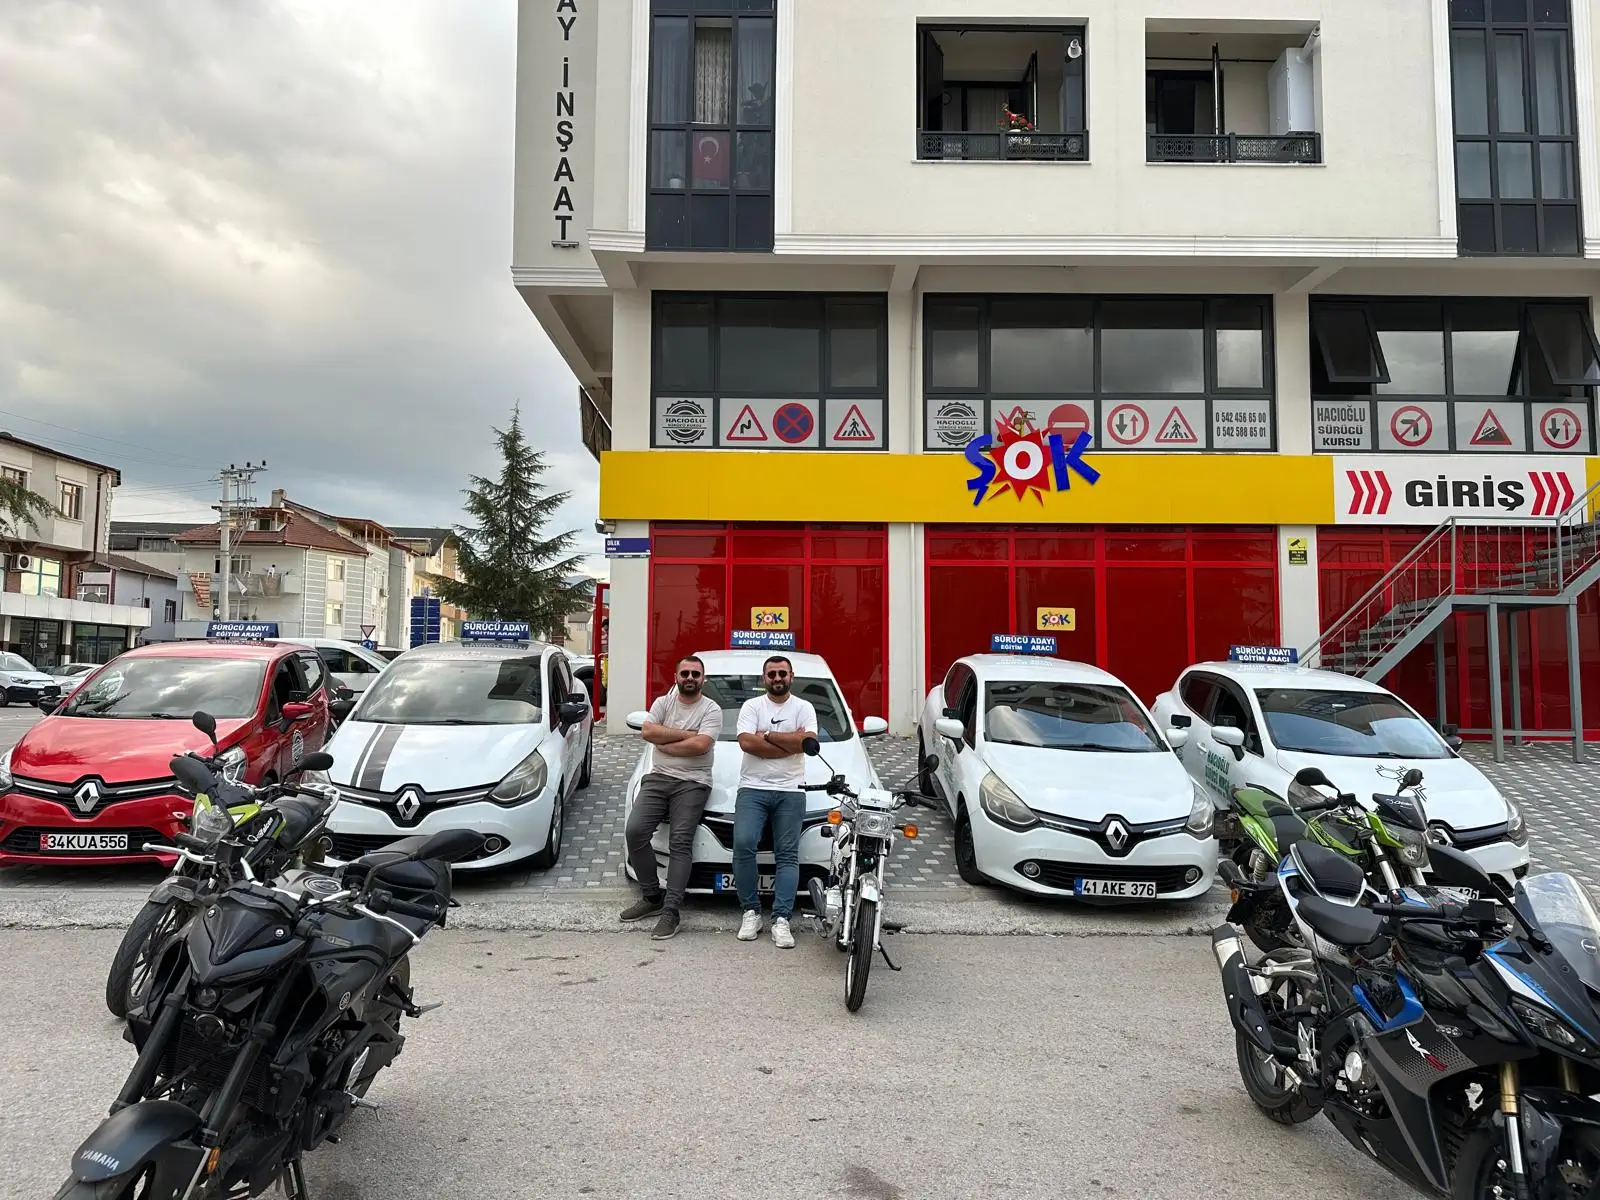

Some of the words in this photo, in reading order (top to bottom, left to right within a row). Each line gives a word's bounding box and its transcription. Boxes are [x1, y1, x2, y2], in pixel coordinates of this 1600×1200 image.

[553, 57, 576, 240] İNŞAAT
[1316, 404, 1366, 423] HACIOĞLU
[1317, 424, 1363, 435] SÜRÜCÜ
[1322, 437, 1361, 447] KURSU
[964, 430, 1101, 507] ŞOK
[1405, 474, 1525, 512] GİRİŞ
[463, 620, 501, 631] SÜRÜCÜ
[502, 623, 529, 632] ADAYI
[755, 612, 785, 628] ŞOK
[1041, 613, 1071, 628] ŞOK
[211, 623, 244, 632] SÜRÜCÜ
[245, 624, 270, 632] ADAYI
[733, 630, 767, 639] SÜRÜCÜ
[768, 632, 793, 640] ADAYI
[994, 634, 1029, 644] SÜRÜCÜ
[1030, 636, 1055, 645] ADAYI
[1000, 643, 1023, 651] EĞİTİM
[1031, 644, 1053, 652] ARACI
[1235, 646, 1267, 655] SÜRÜCÜ
[1268, 647, 1291, 657] ADAYI
[1238, 654, 1265, 662] EĞİTİM
[1266, 655, 1290, 663] ARACI
[1083, 881, 1097, 893] 41
[1101, 882, 1126, 895] AKE
[1130, 883, 1154, 896] 376
[80, 1149, 120, 1171] YAMAHA
